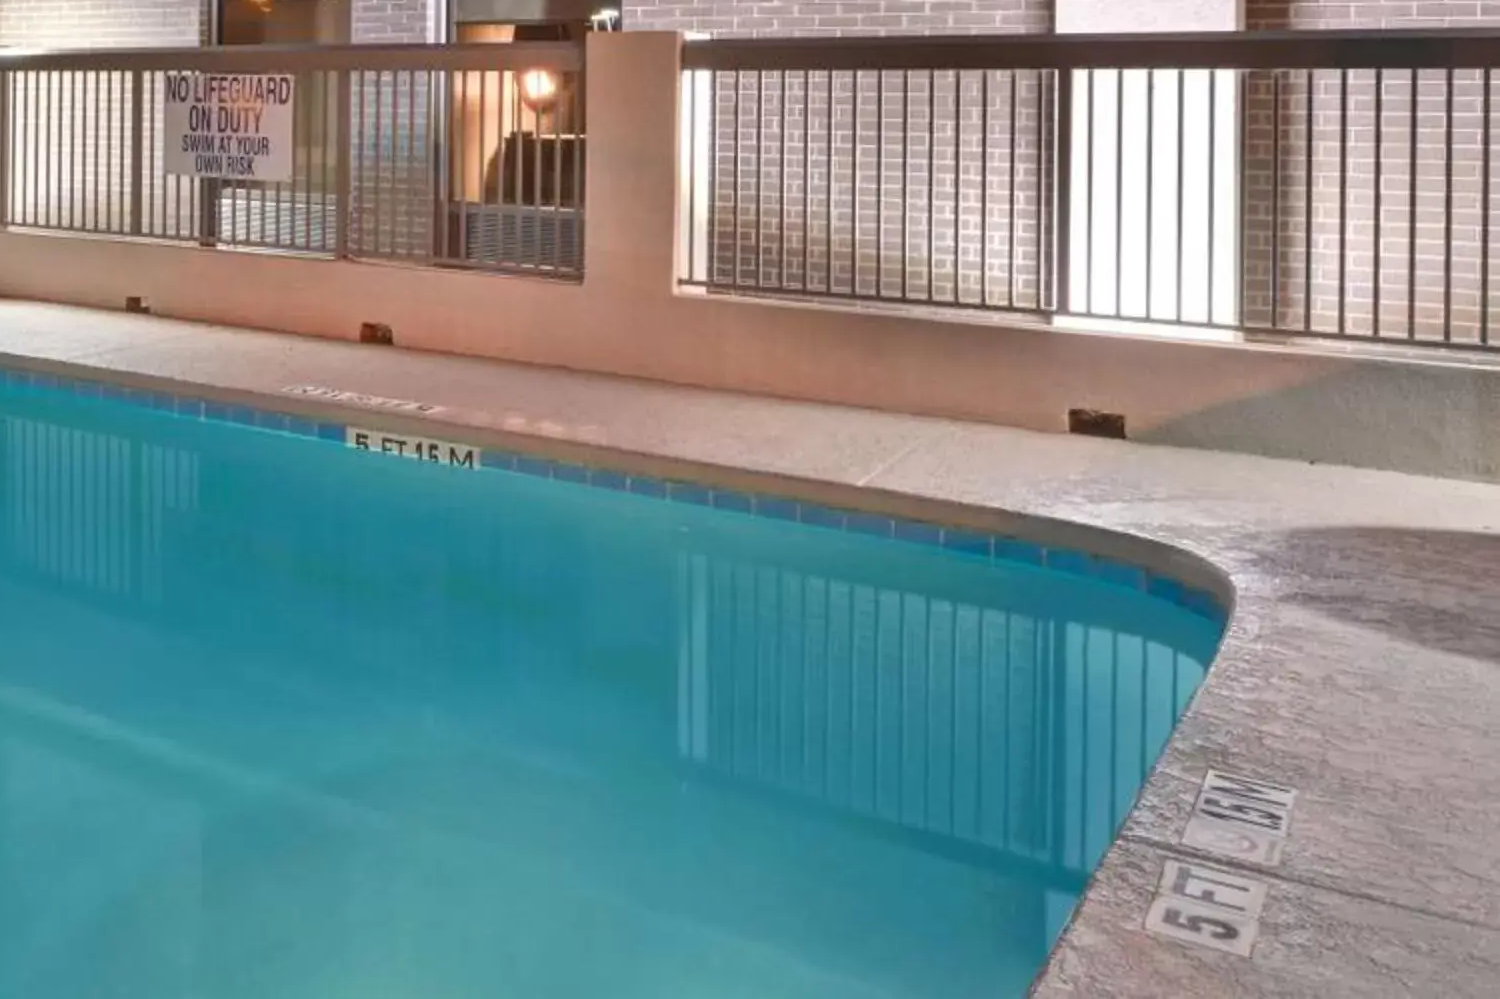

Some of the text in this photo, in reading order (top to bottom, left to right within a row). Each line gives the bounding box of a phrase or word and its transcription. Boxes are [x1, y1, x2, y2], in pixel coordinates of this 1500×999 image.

[166, 76, 291, 105] NO LIFEGUARD
[189, 105, 265, 133] ON DUTY
[182, 134, 270, 156] SWIM AT YOUR
[195, 155, 255, 175] OWN RISK
[355, 433, 369, 450] 5
[381, 437, 407, 456] FT
[449, 446, 473, 469] M
[1162, 865, 1251, 940] 5 FT
